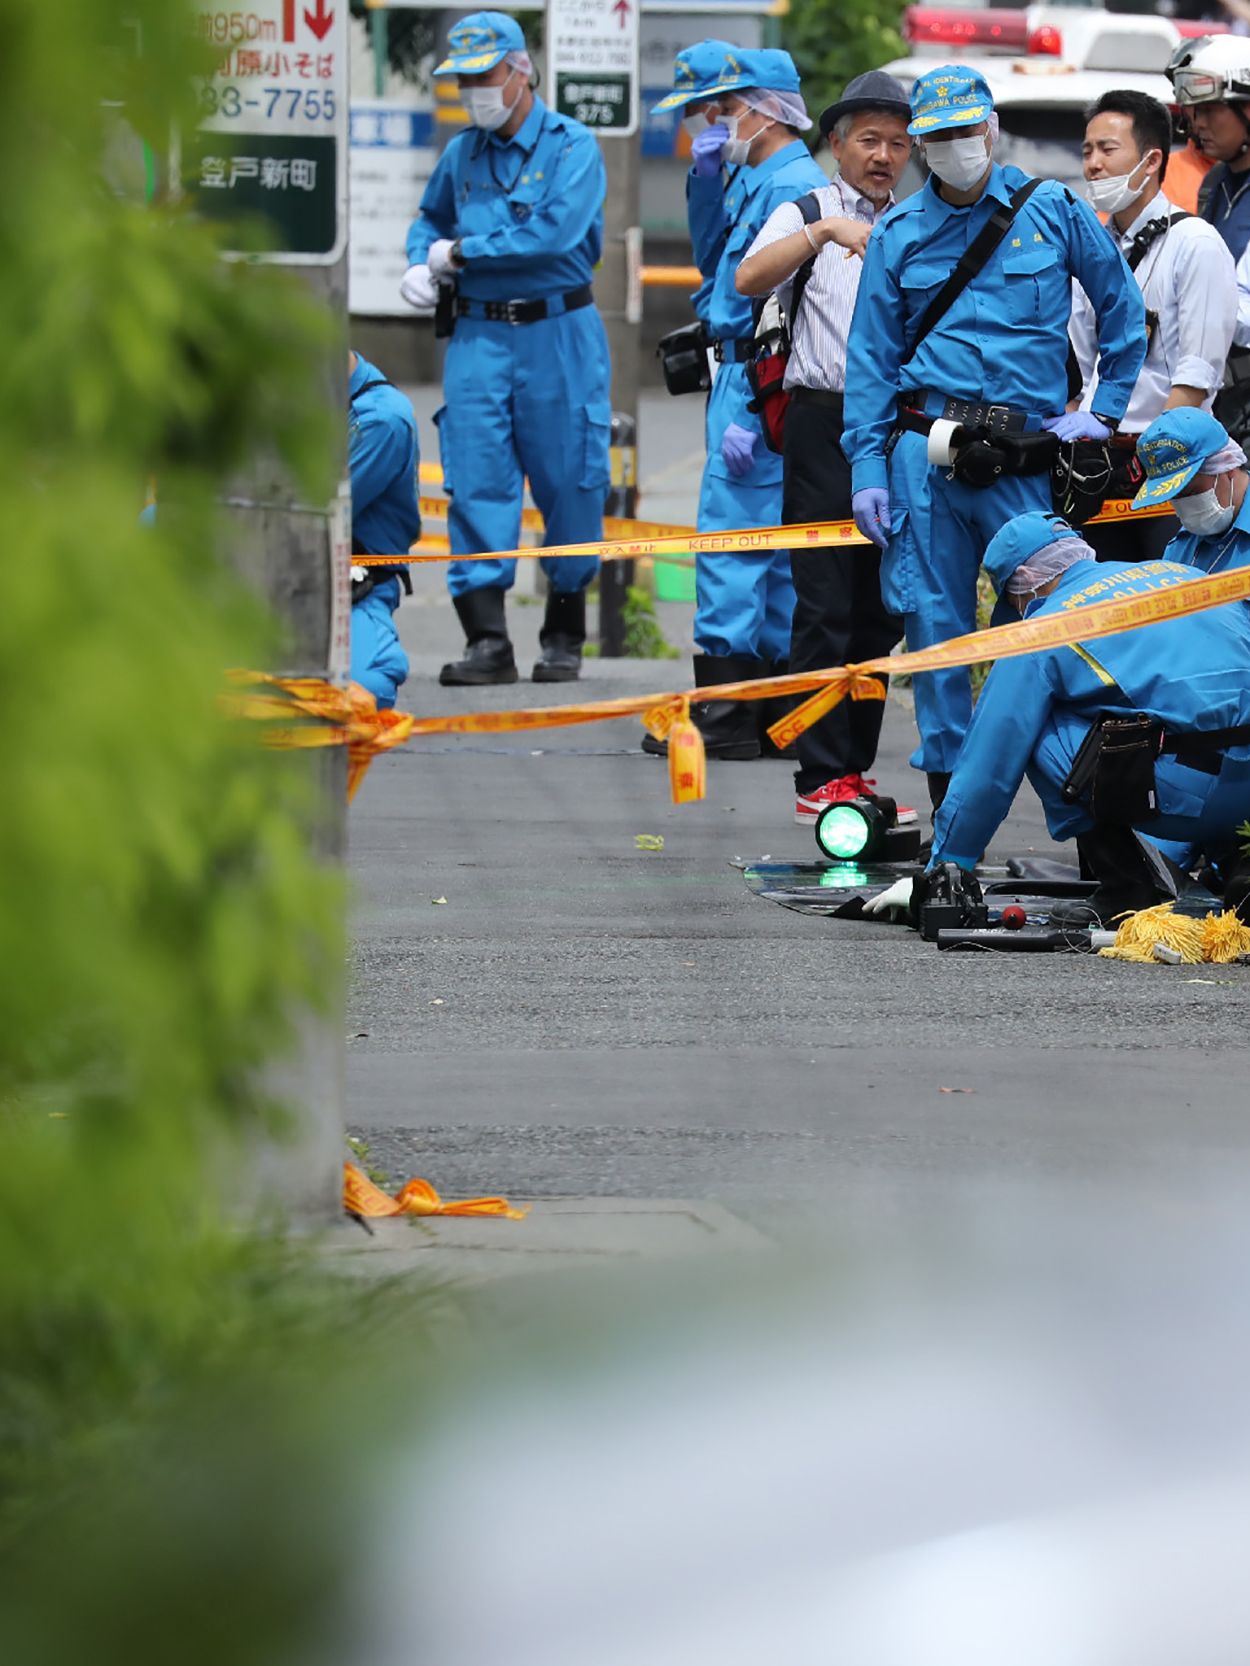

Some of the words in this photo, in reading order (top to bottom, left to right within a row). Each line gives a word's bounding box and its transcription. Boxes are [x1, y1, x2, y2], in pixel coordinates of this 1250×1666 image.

[200, 156, 318, 191] 登戸新町
[689, 537, 733, 551] KEEP
[738, 534, 774, 547] OUT
